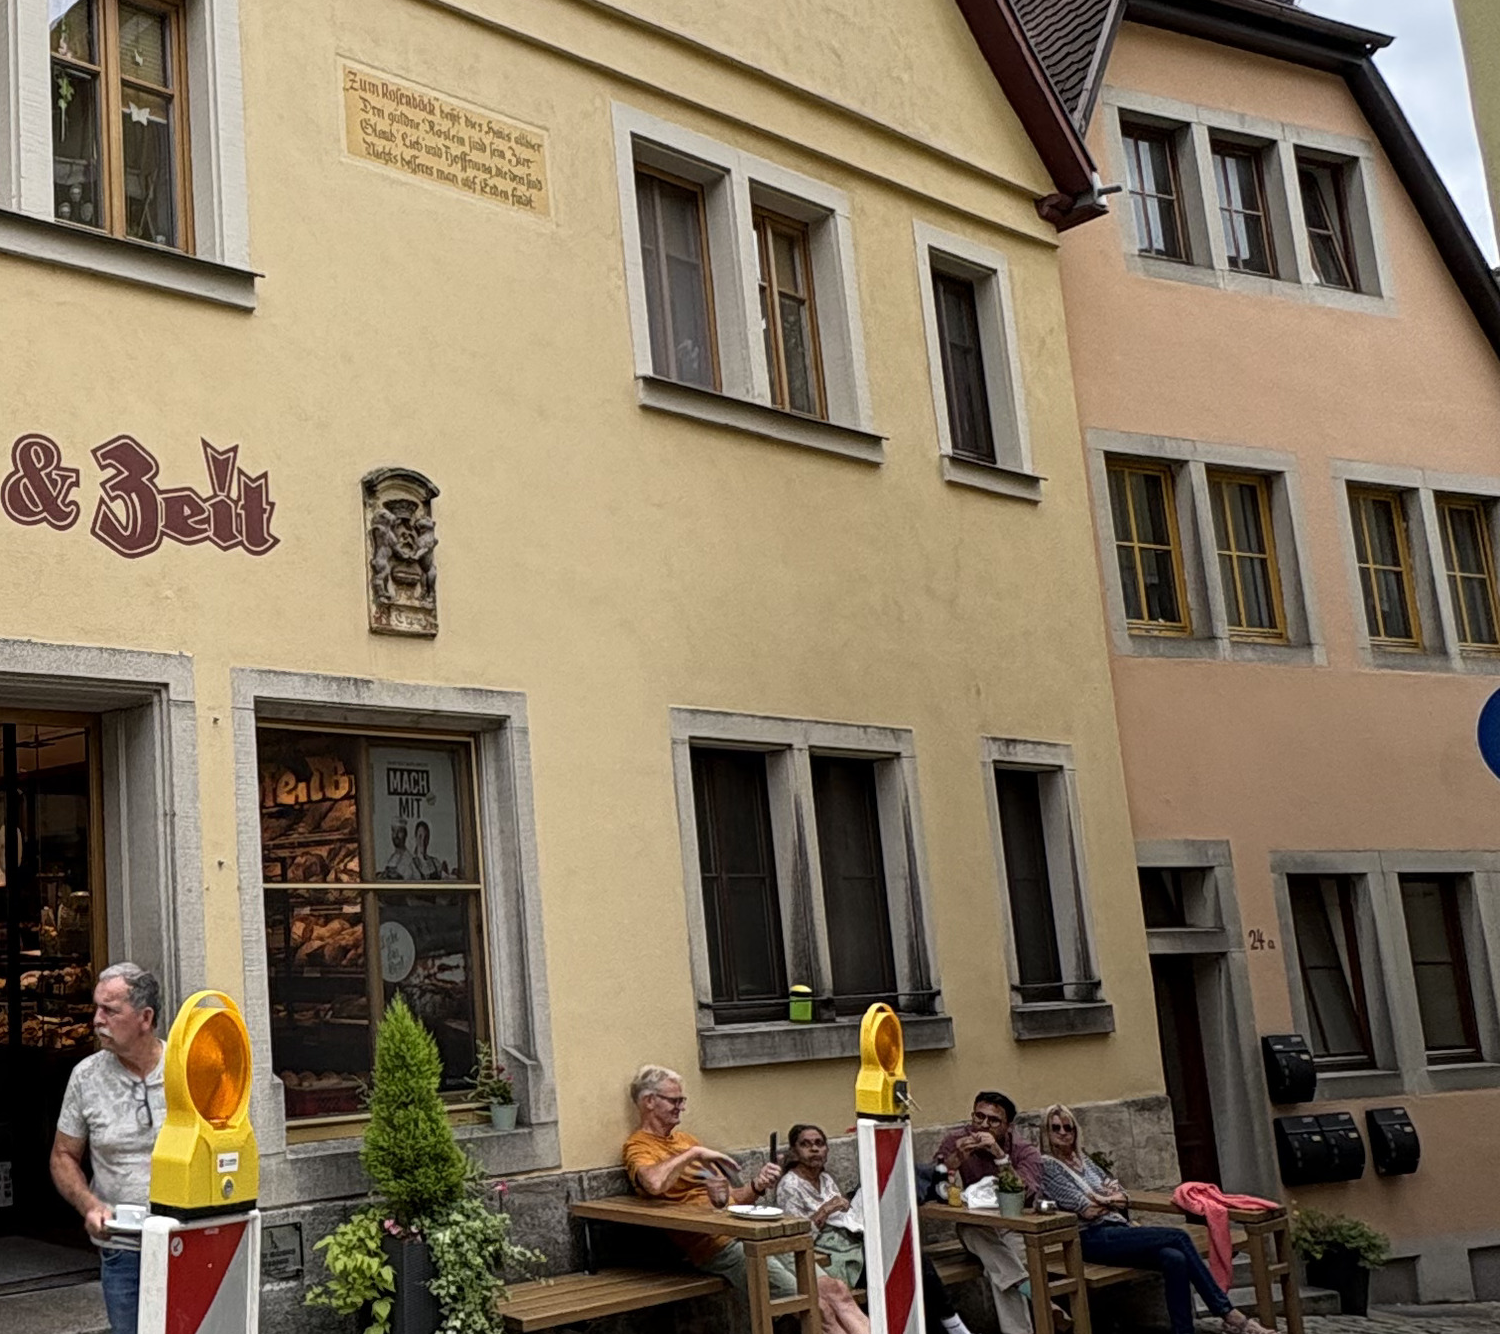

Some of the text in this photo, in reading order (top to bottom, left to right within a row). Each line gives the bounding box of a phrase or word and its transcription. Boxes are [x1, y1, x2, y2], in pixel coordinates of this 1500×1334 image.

[0, 433, 81, 532] &
[90, 434, 282, 560] Zeit
[389, 770, 428, 794] MACH
[399, 797, 422, 819] MIT
